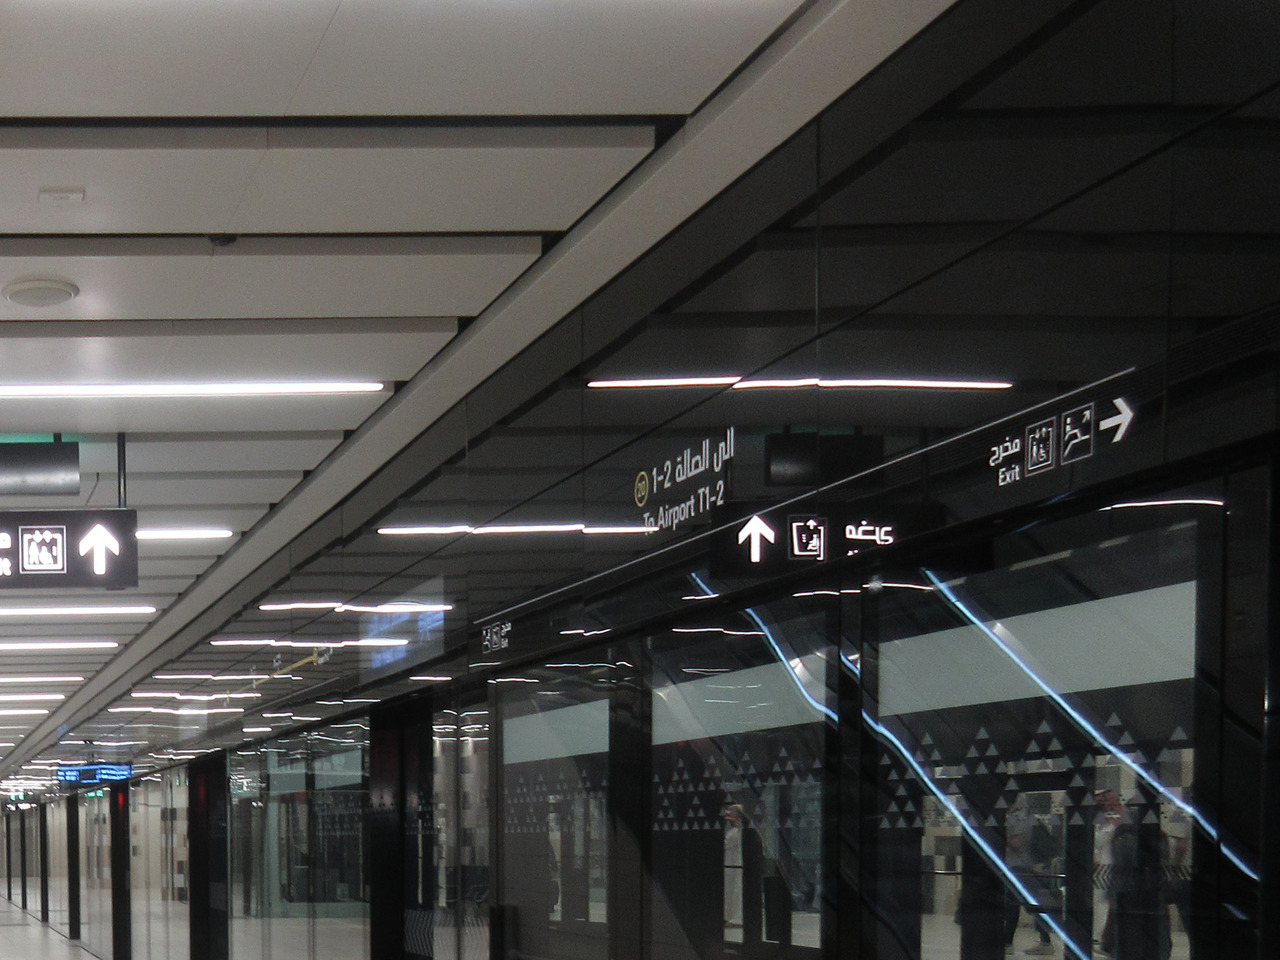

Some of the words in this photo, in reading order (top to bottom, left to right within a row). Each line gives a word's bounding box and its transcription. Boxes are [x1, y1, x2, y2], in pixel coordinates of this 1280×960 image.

[675, 438, 710, 483] الصالة
[989, 436, 1021, 467] مخرج
[652, 460, 672, 494] 1-2
[998, 464, 1020, 486] Exit
[643, 512, 655, 536] To
[658, 495, 695, 531] Airport
[697, 480, 724, 513] T1-2
